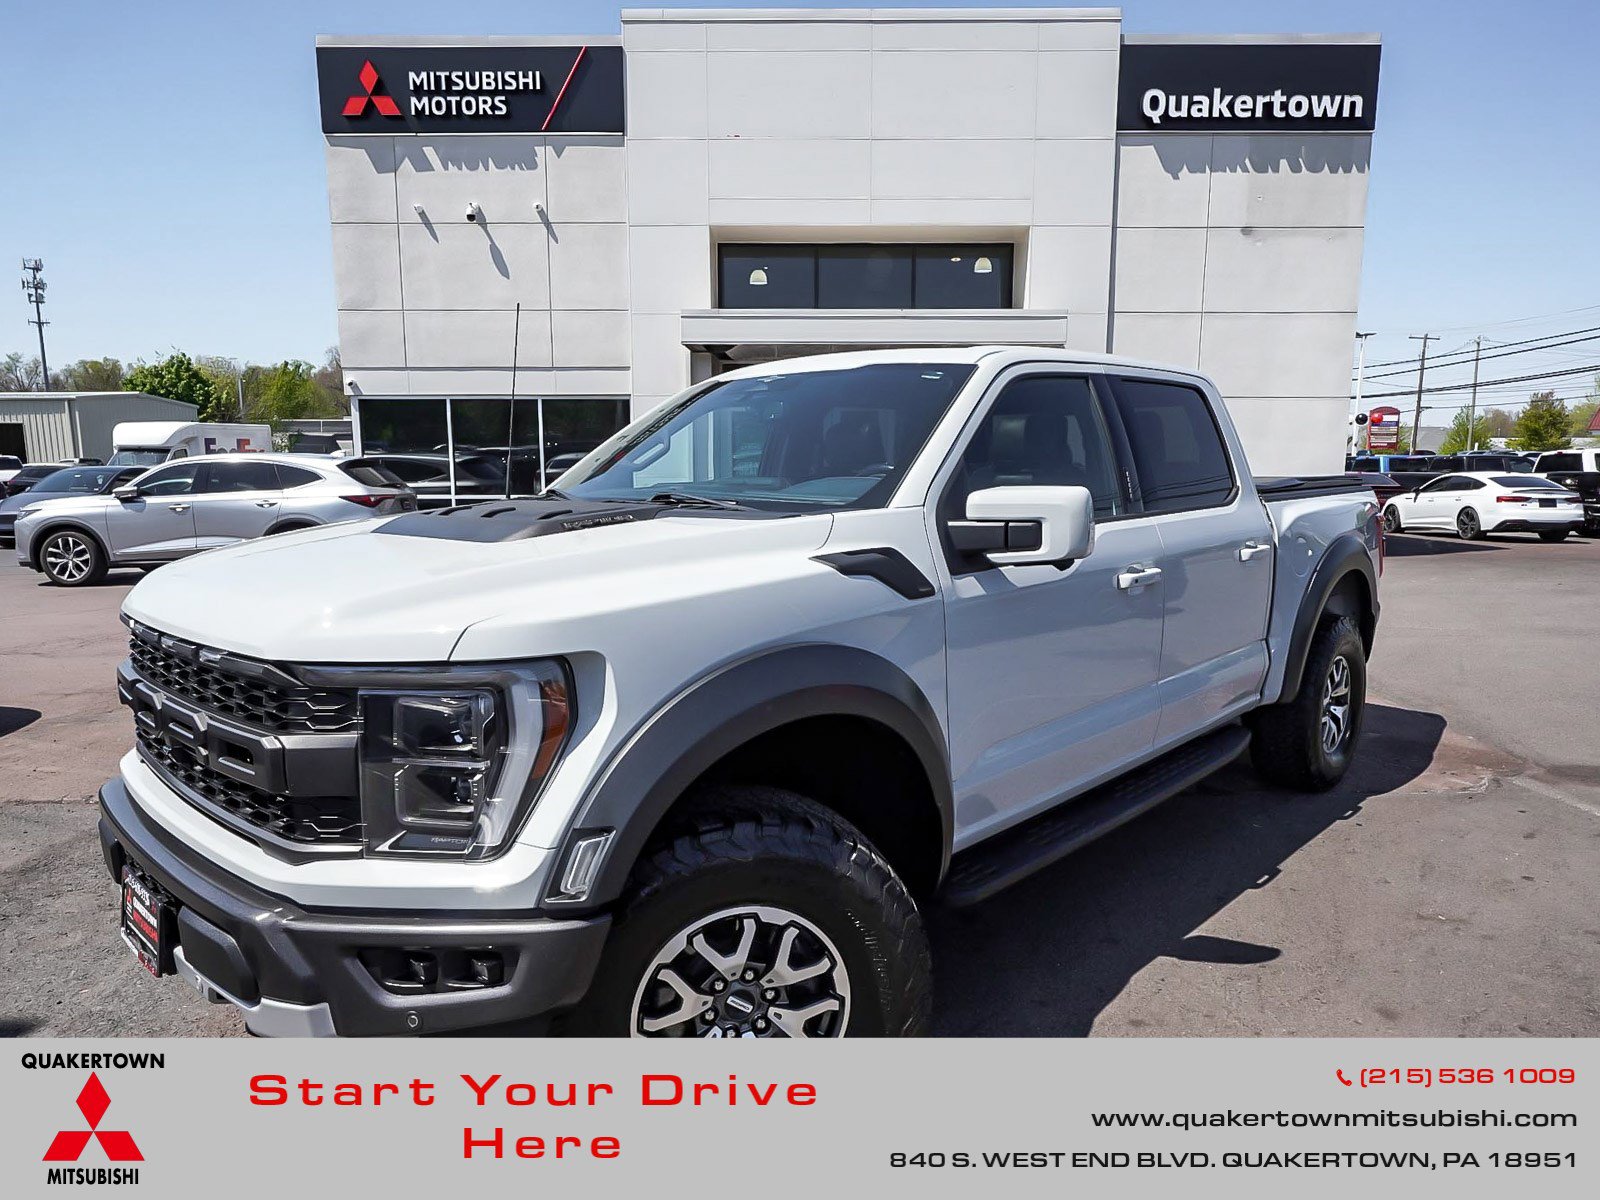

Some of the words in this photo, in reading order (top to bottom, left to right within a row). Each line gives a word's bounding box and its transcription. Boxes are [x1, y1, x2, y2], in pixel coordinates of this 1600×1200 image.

[408, 70, 541, 91] MITSUBISHI
[410, 95, 507, 116] MOTORS
[1142, 87, 1363, 124] Quakertown
[204, 438, 265, 454] FdE
